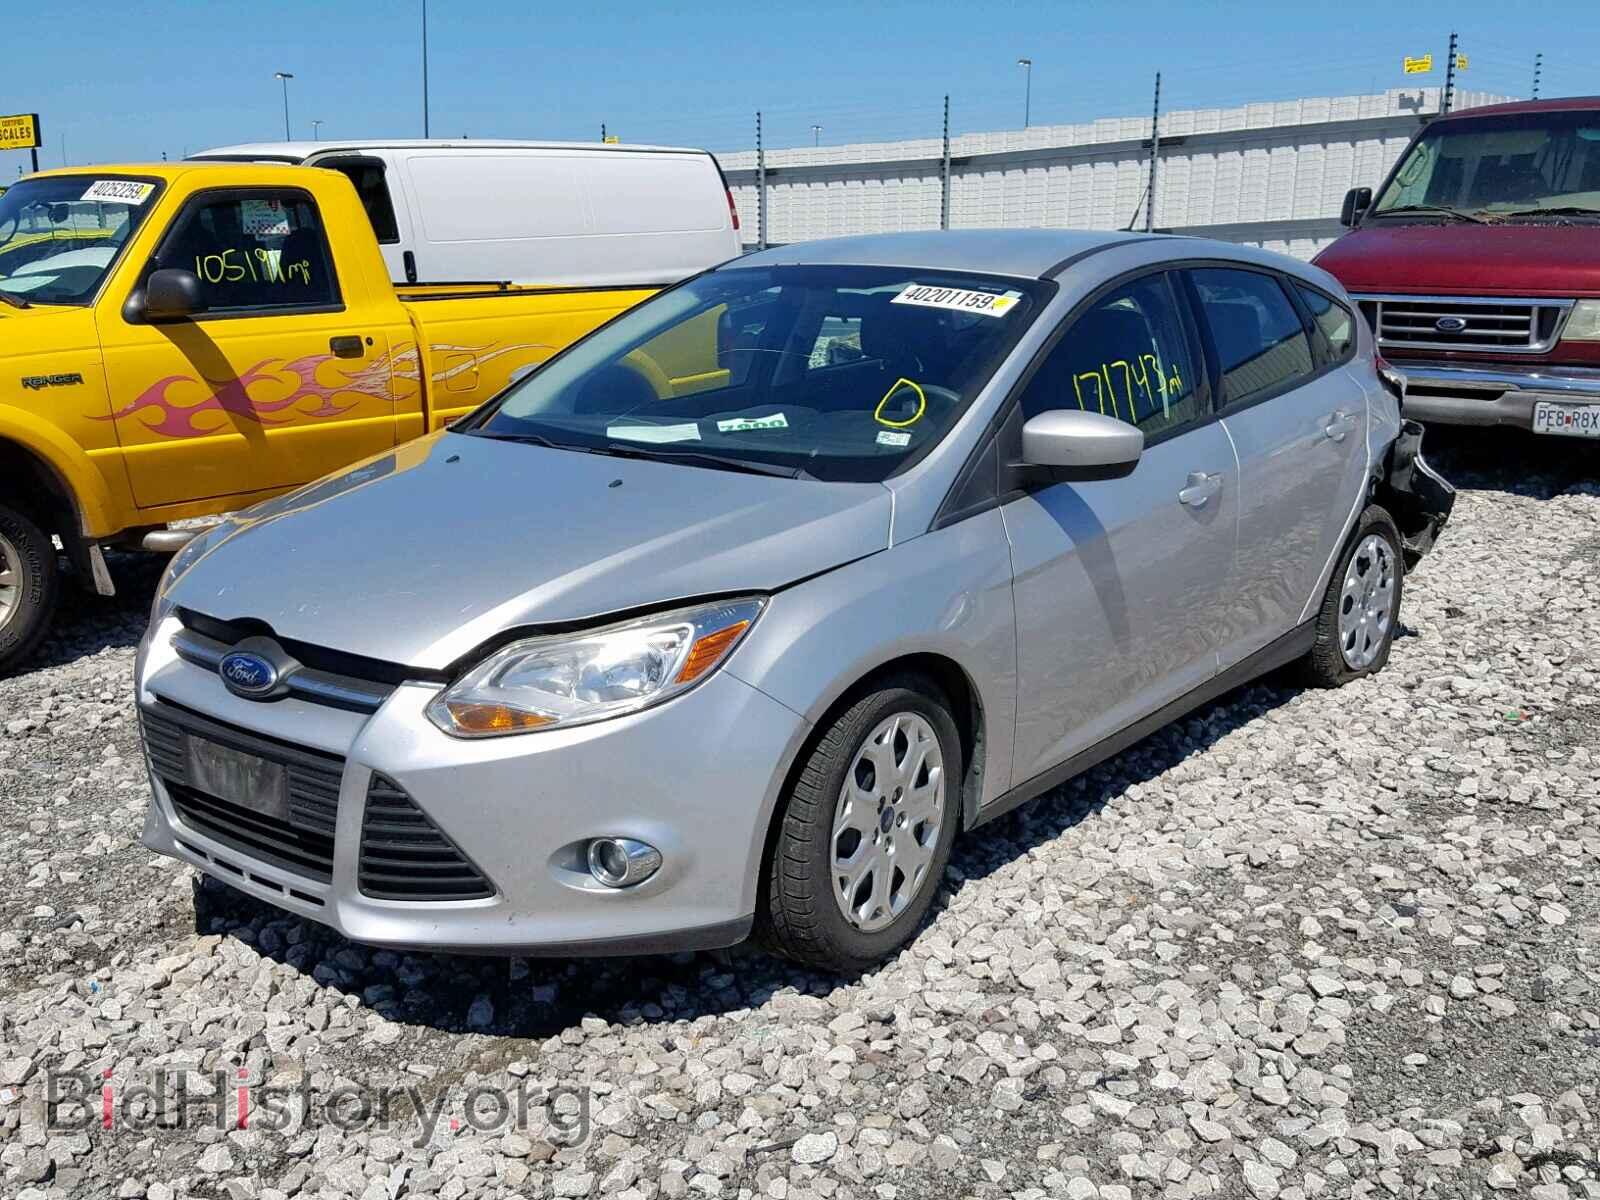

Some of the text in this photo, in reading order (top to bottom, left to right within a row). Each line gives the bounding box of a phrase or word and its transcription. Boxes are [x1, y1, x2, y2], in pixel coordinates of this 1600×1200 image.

[904, 286, 996, 309] 40201159
[1537, 410, 1600, 429] PE8 R8X
